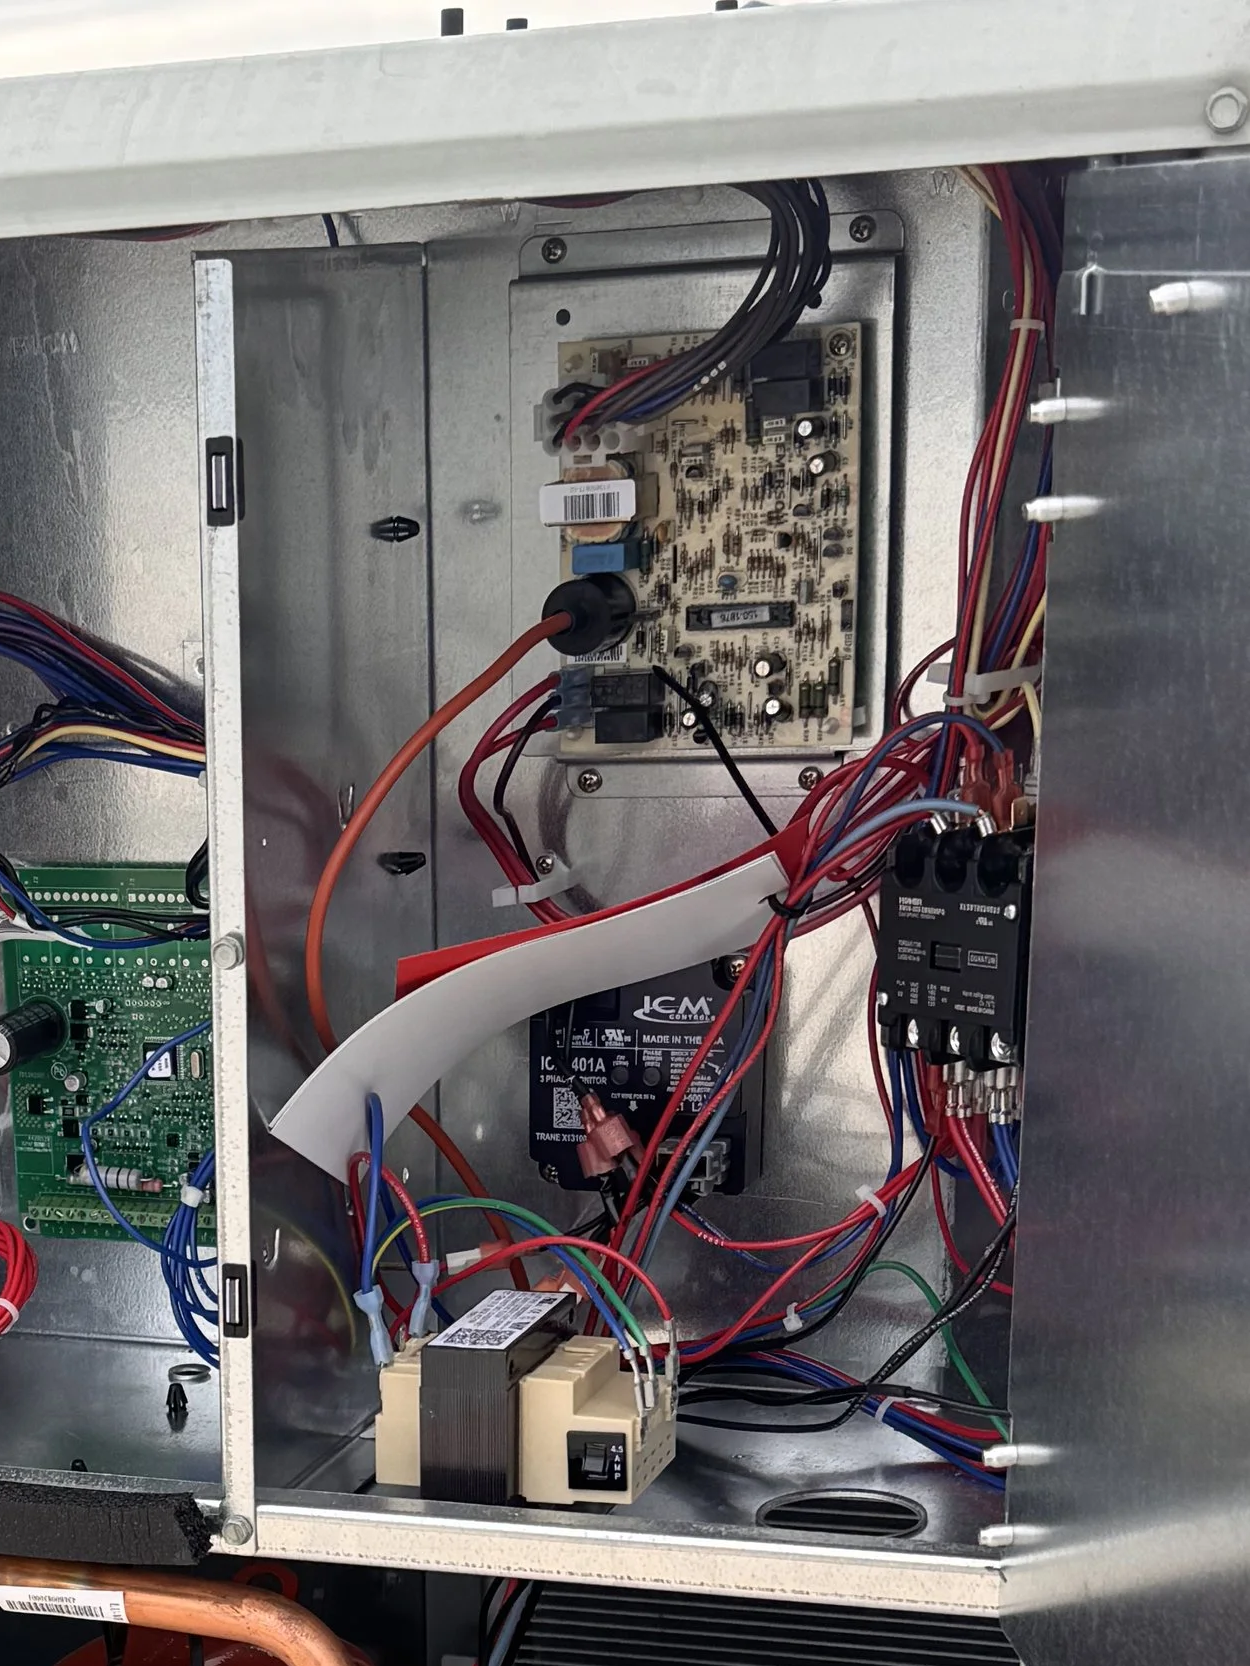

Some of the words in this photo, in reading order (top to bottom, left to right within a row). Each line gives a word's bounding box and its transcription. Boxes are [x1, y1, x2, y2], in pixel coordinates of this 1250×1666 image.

[642, 1034, 669, 1044] MADE
[672, 1036, 680, 1044] IN
[682, 1036, 702, 1045] THE
[540, 1056, 558, 1071] IC
[572, 1057, 606, 1073] 401A
[536, 1132, 561, 1142] TRANE
